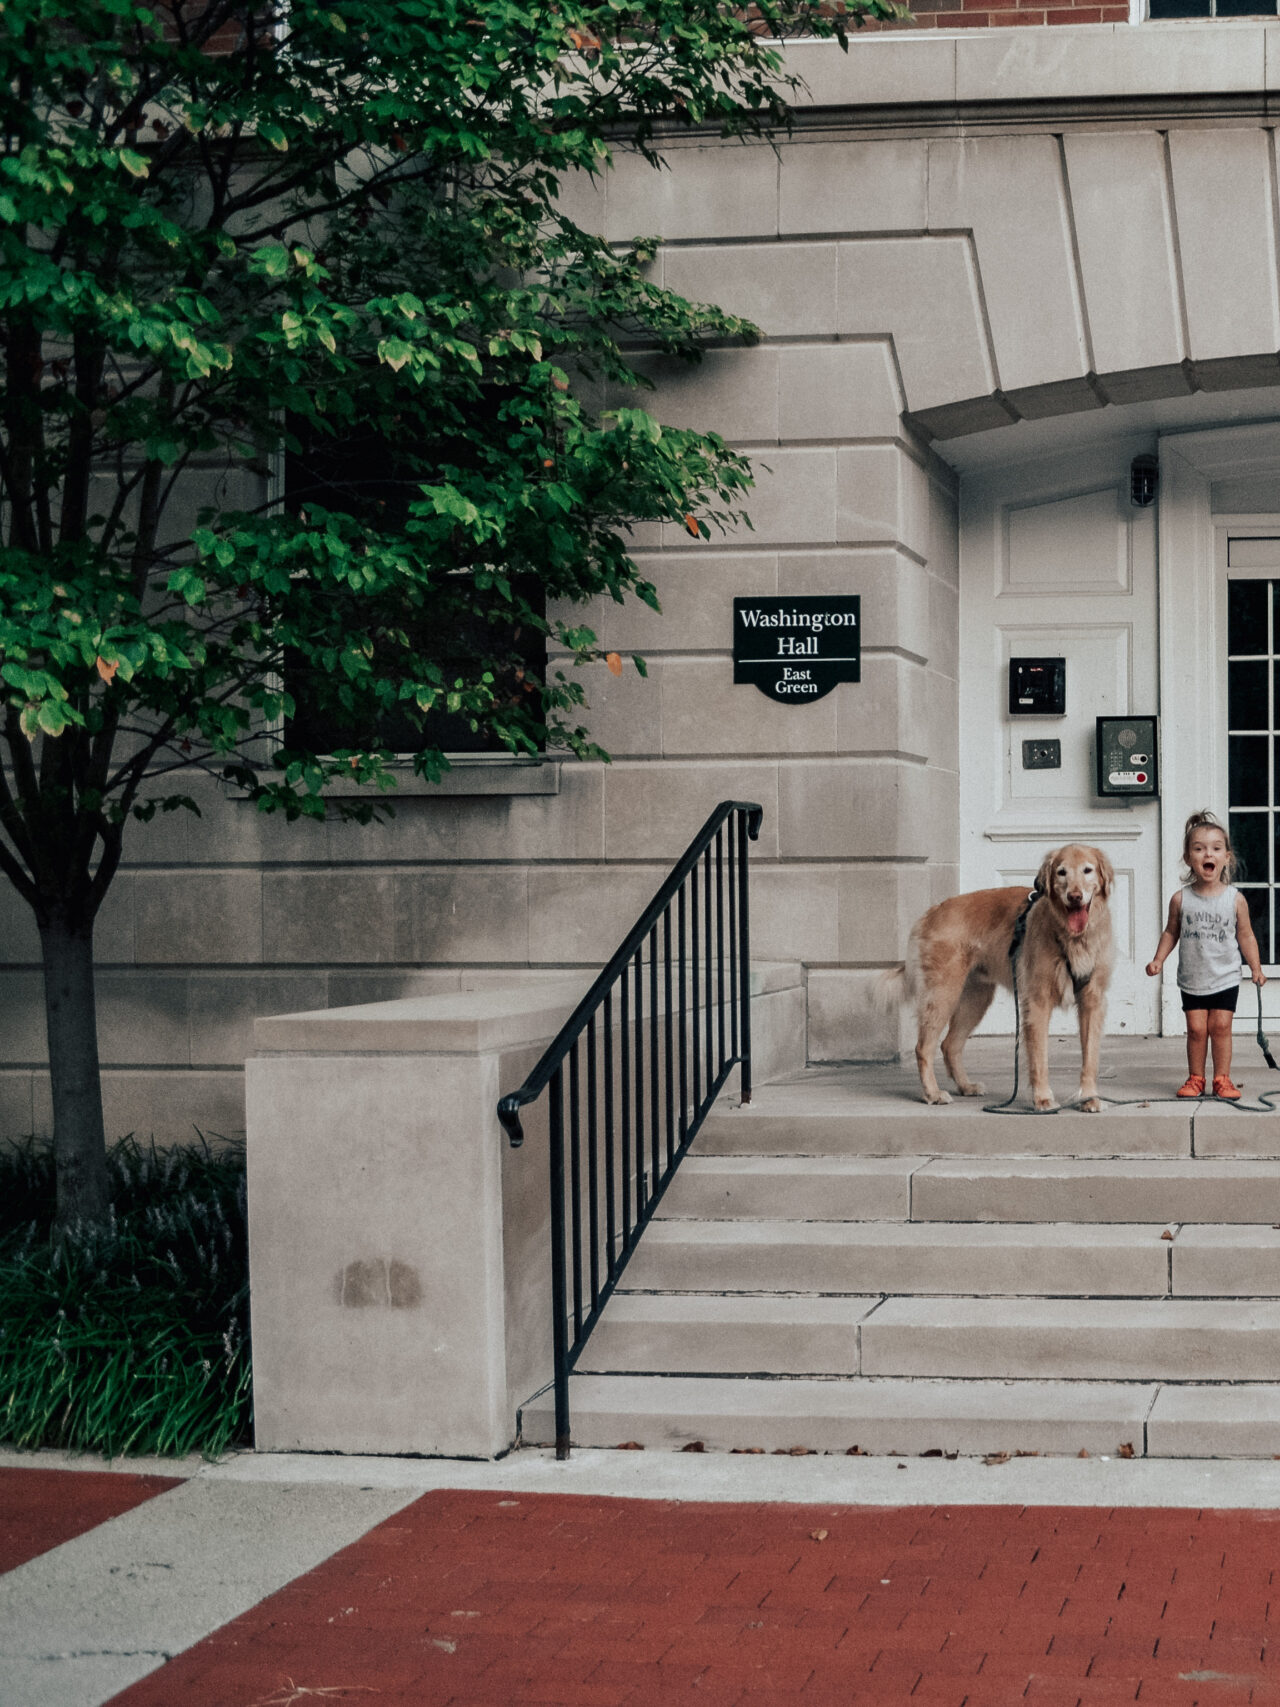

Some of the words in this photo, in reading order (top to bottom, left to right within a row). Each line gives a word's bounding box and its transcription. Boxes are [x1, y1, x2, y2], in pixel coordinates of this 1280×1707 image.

[740, 609, 856, 632] Washington
[777, 637, 819, 655] Hall
[783, 667, 811, 680] East
[775, 681, 818, 694] Green
[1194, 911, 1222, 923] WILD
